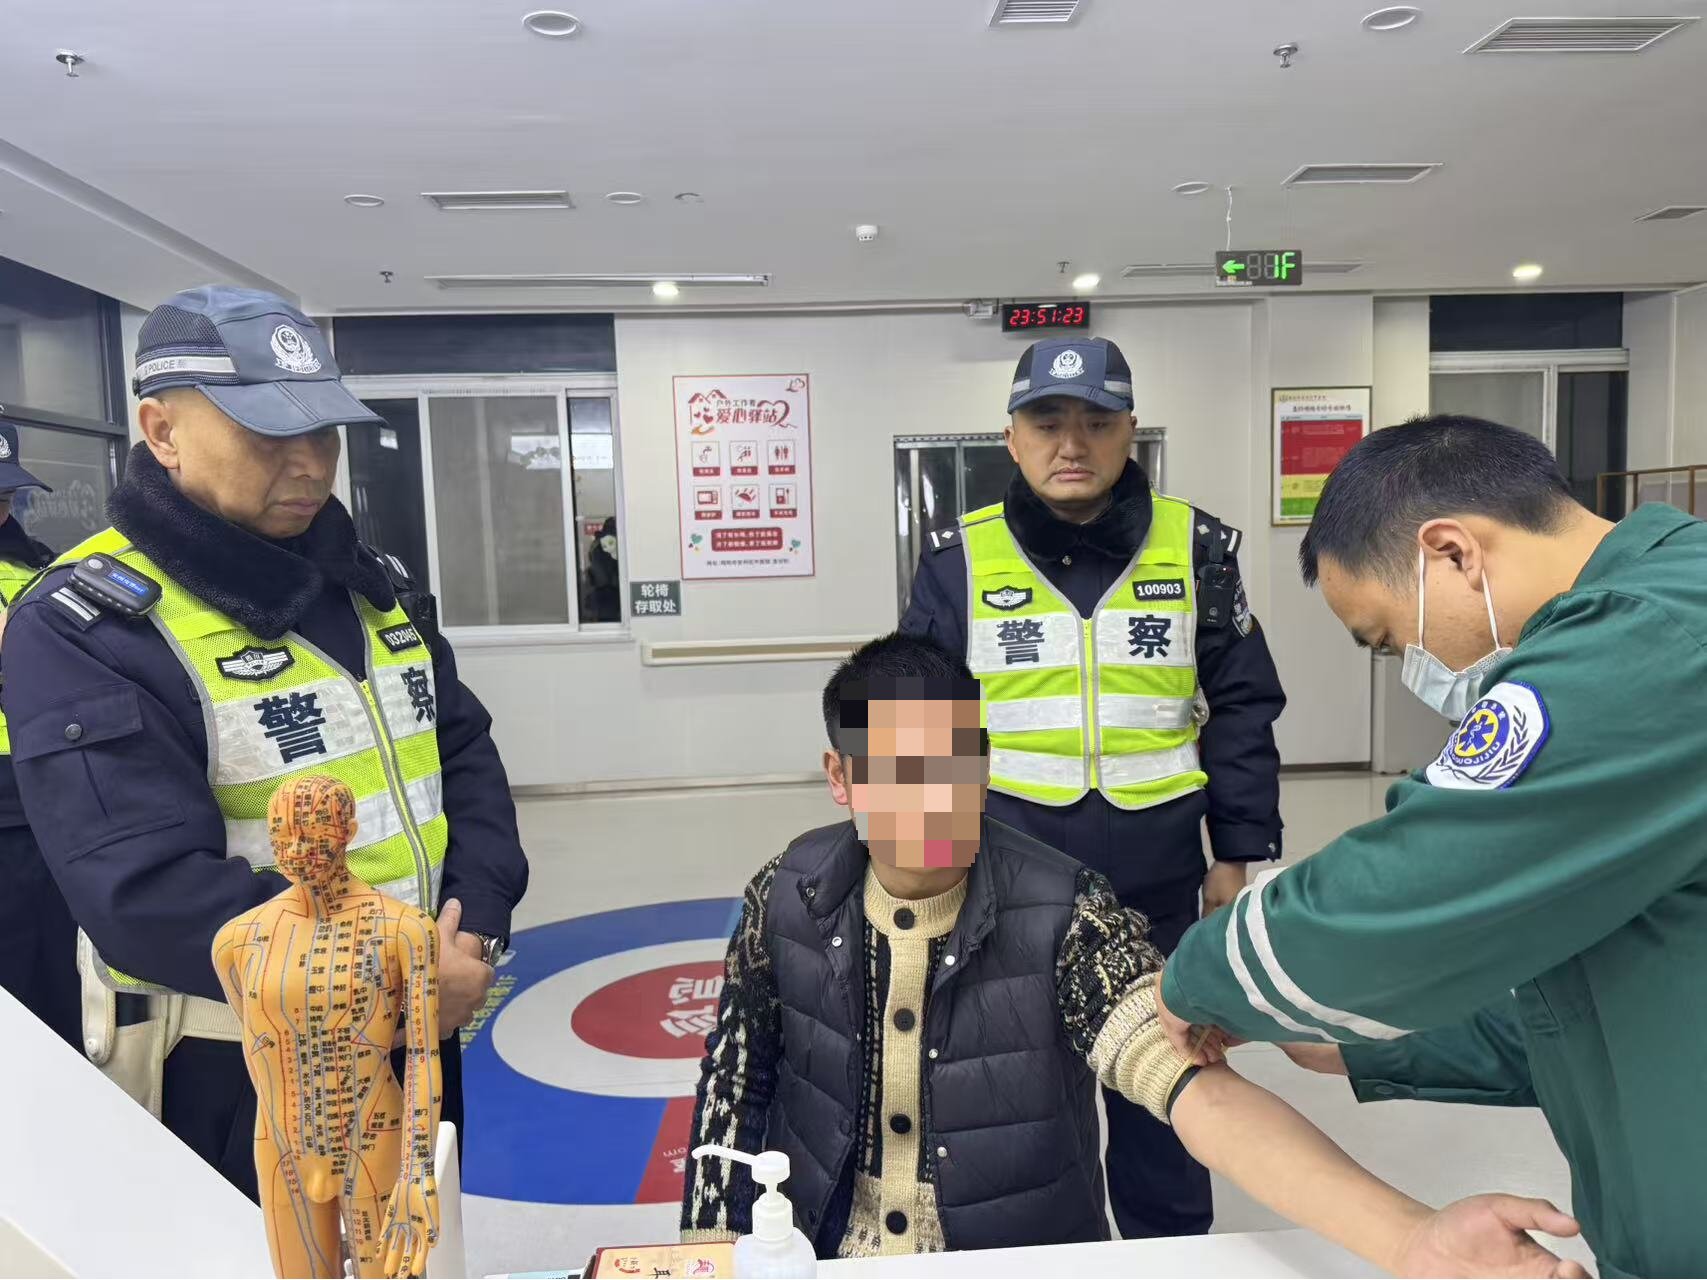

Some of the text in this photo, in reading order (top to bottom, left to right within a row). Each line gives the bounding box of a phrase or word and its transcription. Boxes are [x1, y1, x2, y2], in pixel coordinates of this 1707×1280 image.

[1008, 306, 1084, 328] 23:51:23
[149, 358, 176, 374] POLICE
[716, 408, 778, 424] 爱心驿站
[641, 583, 669, 598] 轮椅
[1136, 582, 1182, 597] 100903
[634, 599, 676, 614] 存取处
[996, 614, 1172, 665] 警 察
[253, 666, 436, 764] 警 察
